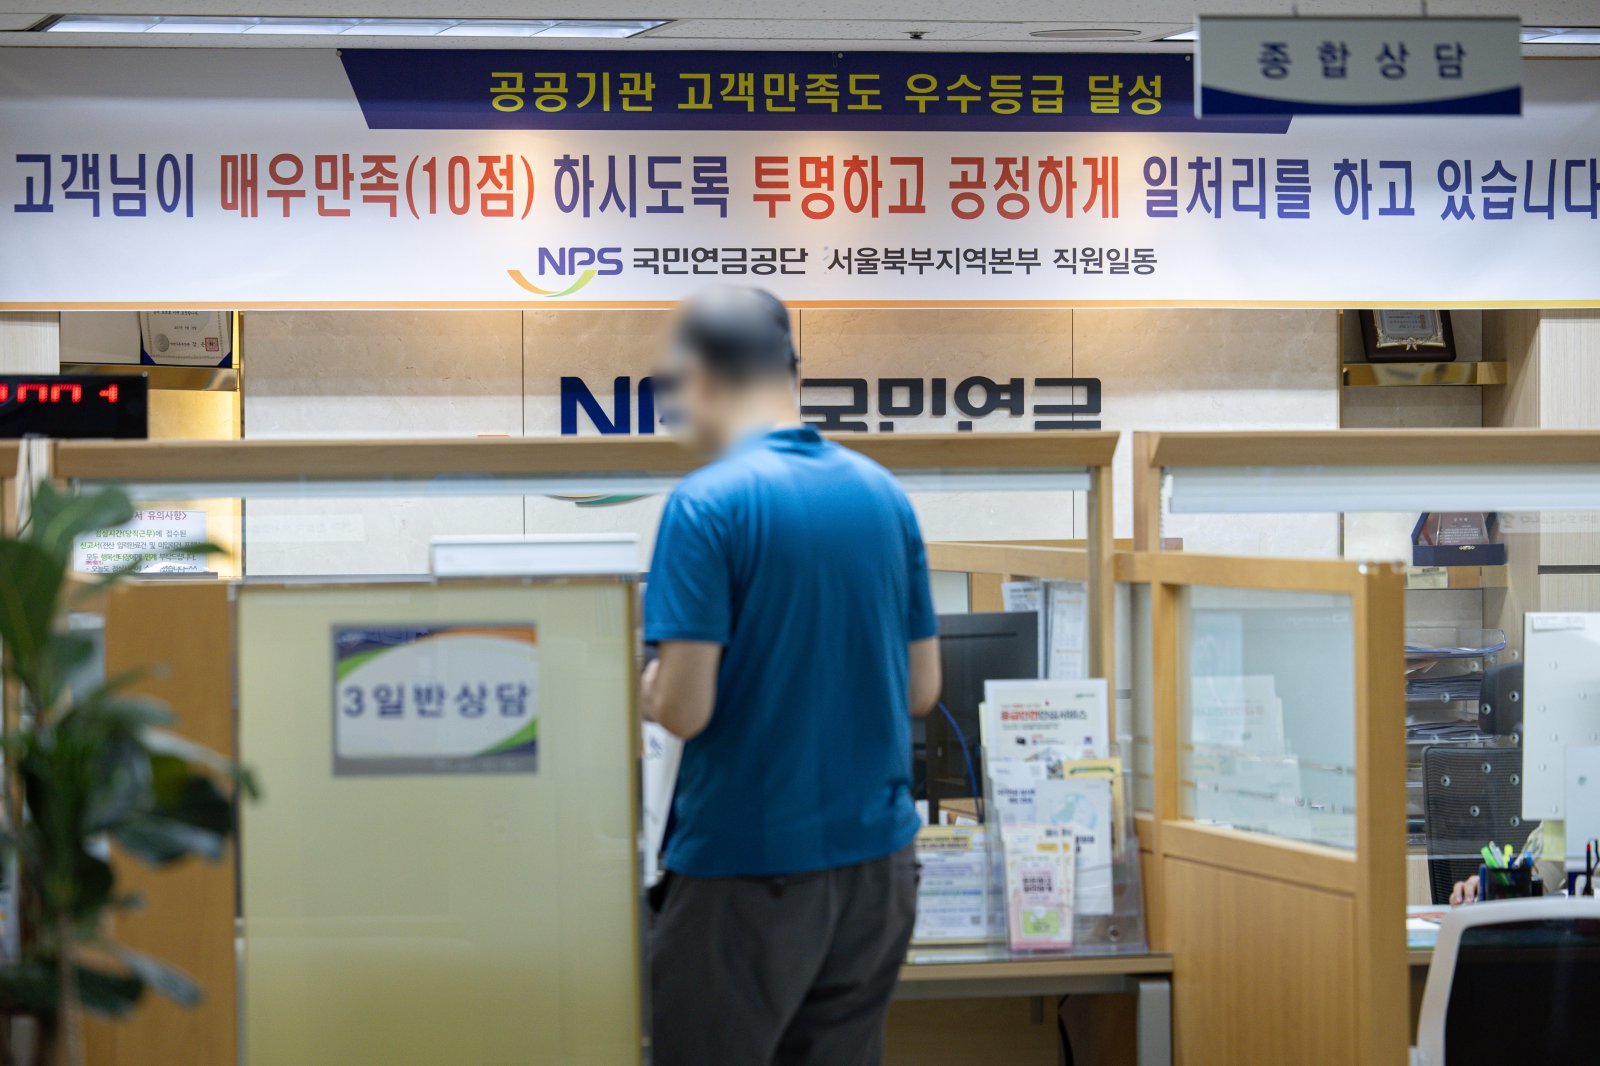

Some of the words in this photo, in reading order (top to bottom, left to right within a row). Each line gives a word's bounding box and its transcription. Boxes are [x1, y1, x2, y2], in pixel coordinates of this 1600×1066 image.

[490, 72, 656, 113] 공공기관
[678, 73, 882, 113] 고객만족도
[905, 74, 1065, 115] 우수등급
[1088, 75, 1163, 115] 달성
[14, 153, 194, 218] 고객님이
[220, 153, 535, 219] 매우만족(10점)
[554, 154, 730, 219] 하시도록
[753, 153, 924, 220] 투명하고
[949, 155, 1120, 220] 공정하게
[1143, 156, 1312, 220] 일처리를
[1334, 157, 1415, 221] 하고
[1437, 158, 1600, 221] 있습니다
[538, 247, 623, 276] NPS
[633, 247, 808, 276] 국민연금공단
[828, 247, 1042, 276] 서울북부지역본부
[1052, 247, 1158, 276] 직원일동
